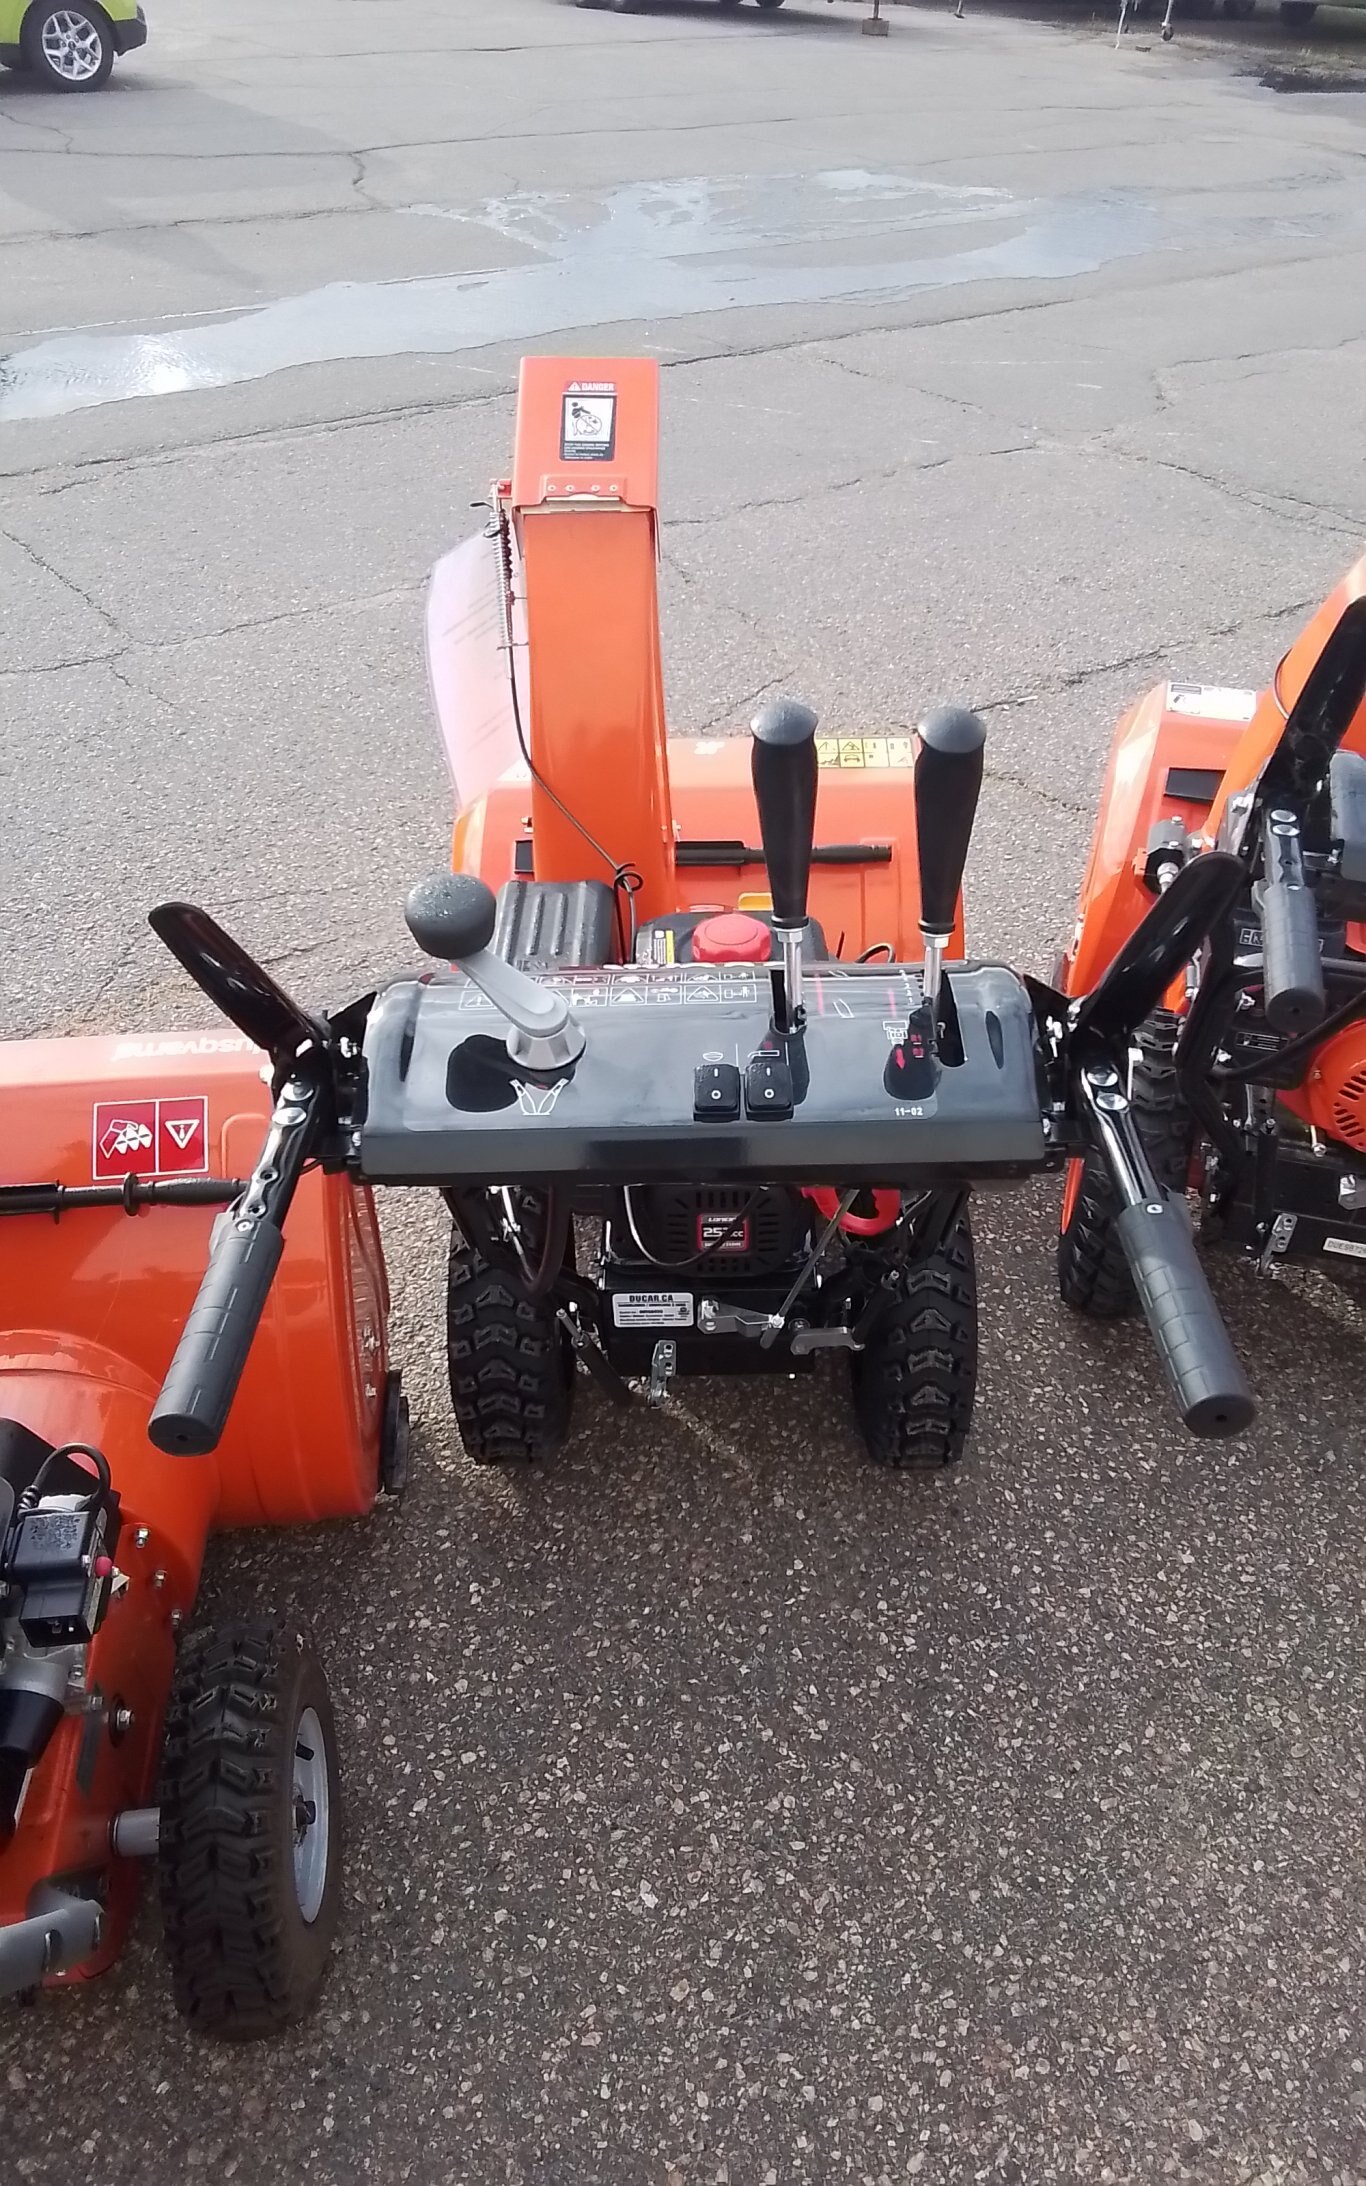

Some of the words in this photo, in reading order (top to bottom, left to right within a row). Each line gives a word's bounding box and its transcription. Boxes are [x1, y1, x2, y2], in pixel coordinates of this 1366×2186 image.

[581, 382, 615, 391] DANGER
[894, 1107, 924, 1117] 11-02
[629, 1294, 674, 1303] DUCAR.CA
